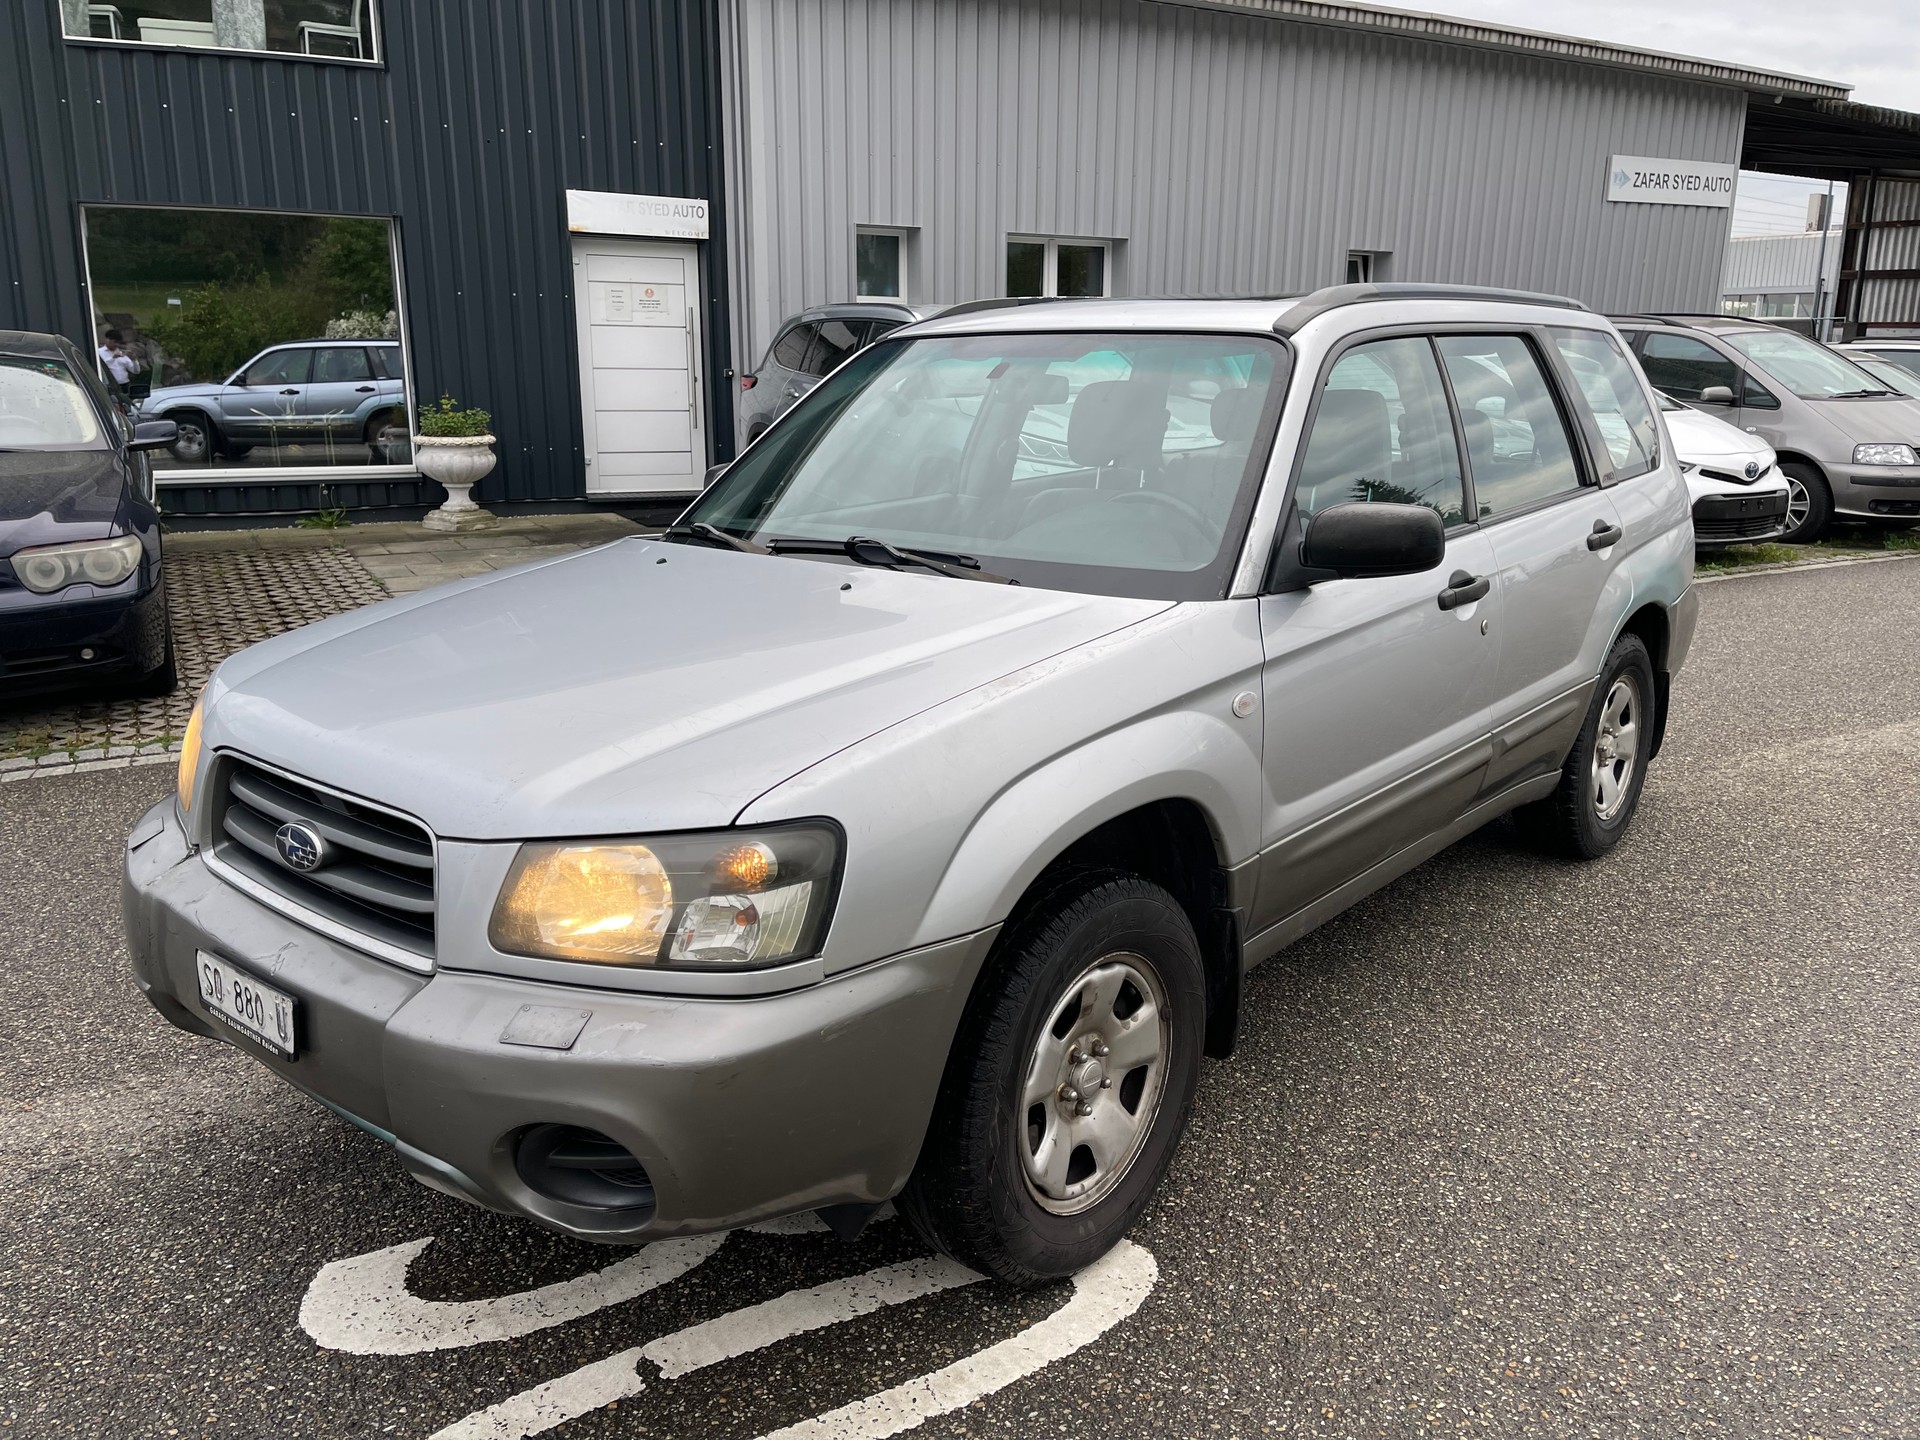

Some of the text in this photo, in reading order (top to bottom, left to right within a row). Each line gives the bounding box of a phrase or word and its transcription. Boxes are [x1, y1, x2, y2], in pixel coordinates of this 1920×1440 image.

[1633, 172, 1732, 193] ZAFAR SYED AUTO
[638, 203, 670, 217] SYED
[673, 205, 705, 219] AUTO
[234, 980, 264, 1027] 880
[275, 997, 288, 1041] U
